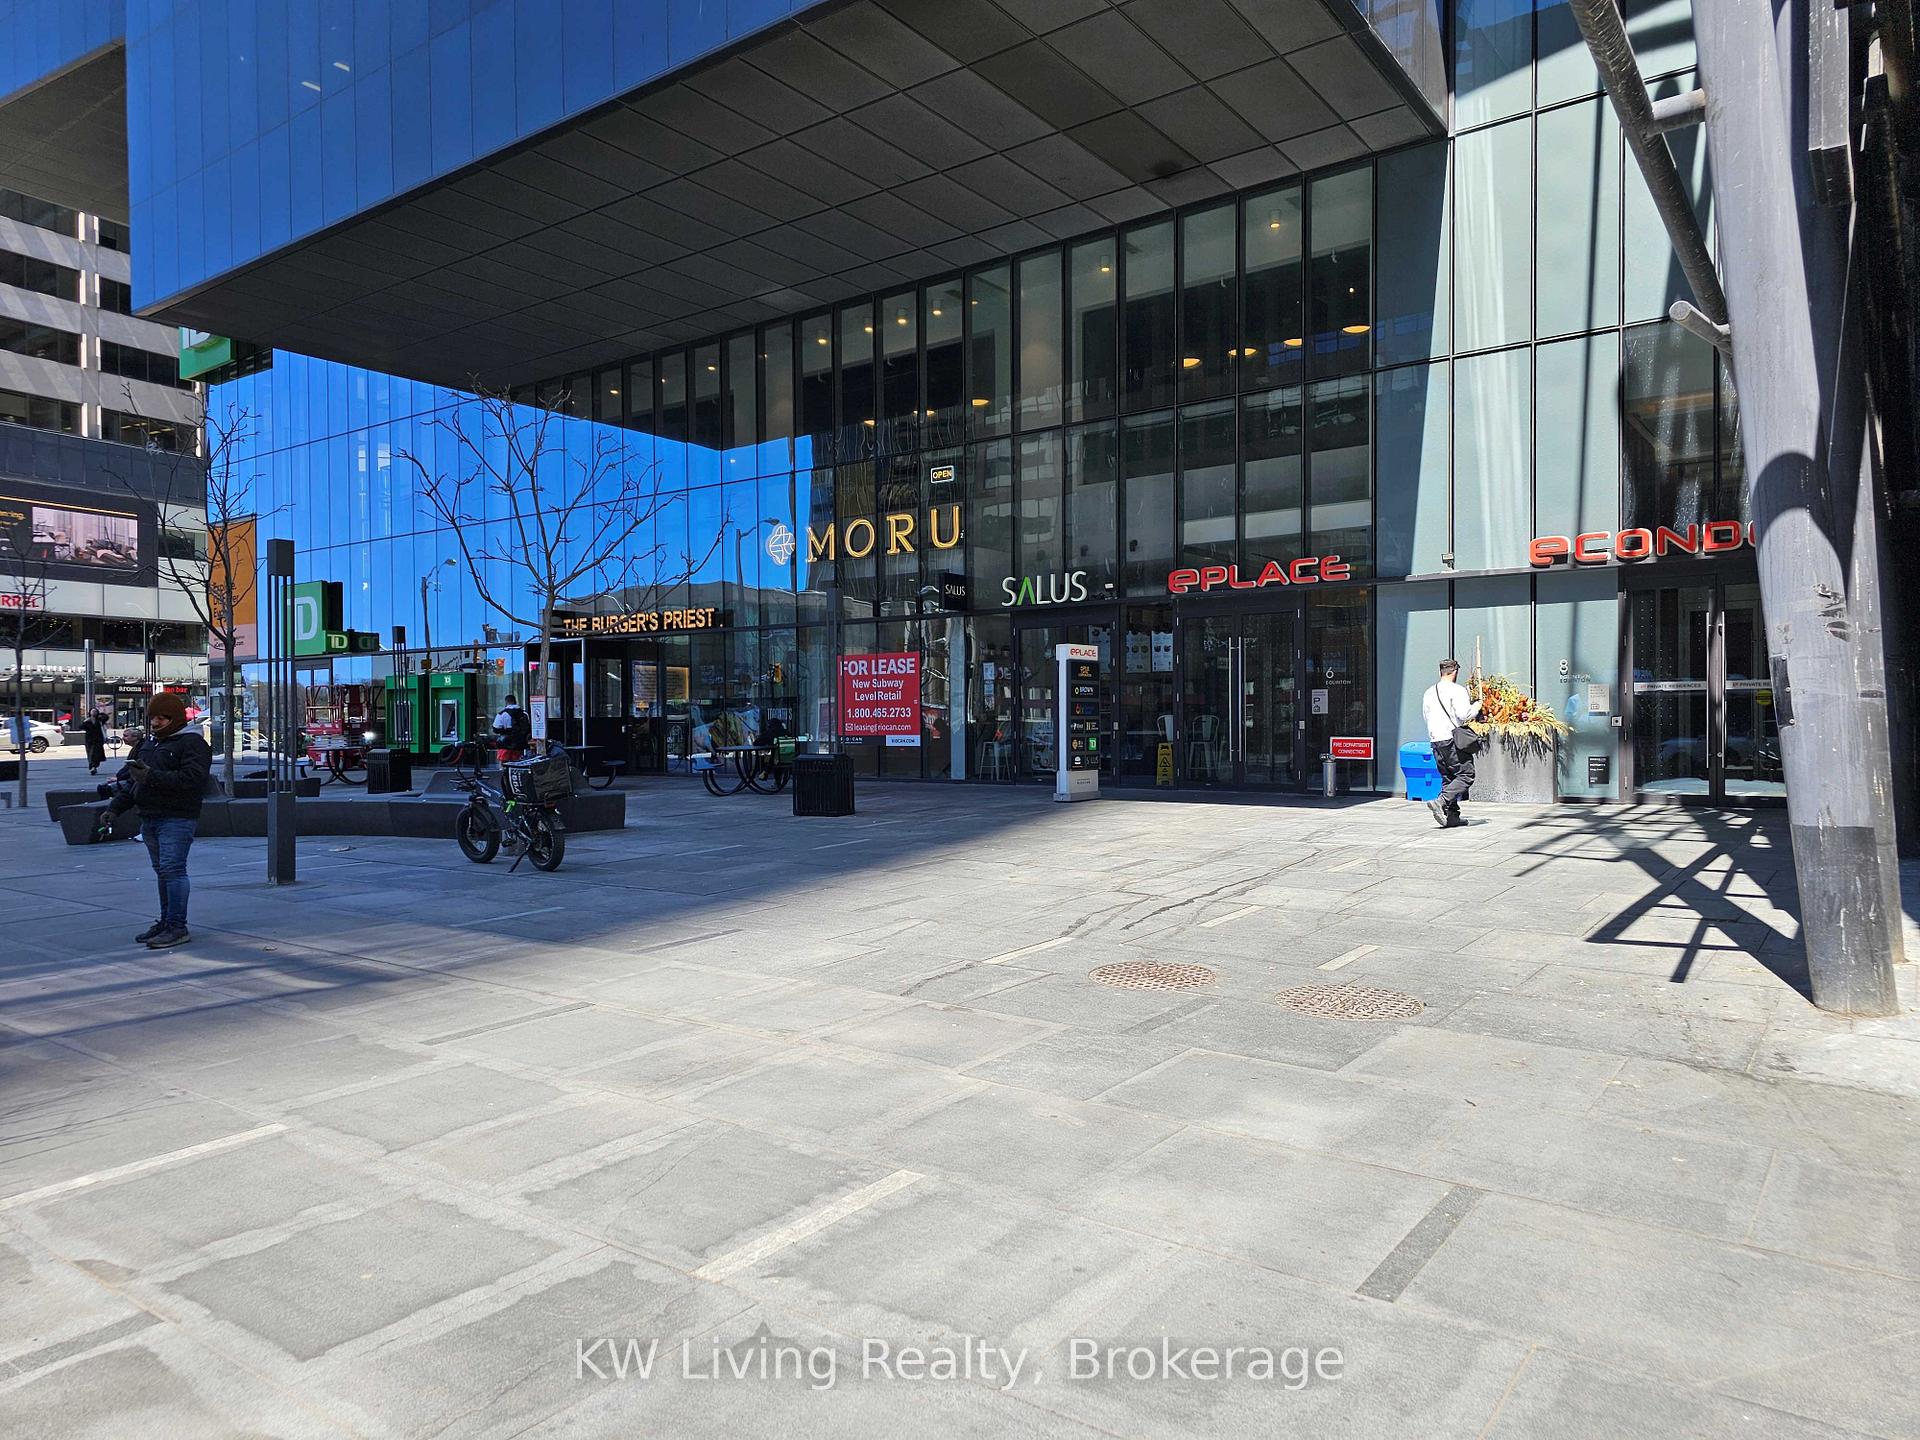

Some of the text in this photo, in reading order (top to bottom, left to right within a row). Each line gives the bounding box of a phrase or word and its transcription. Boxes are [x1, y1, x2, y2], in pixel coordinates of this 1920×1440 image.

[932, 469, 952, 480] OPEN
[806, 505, 960, 563] MORU
[1001, 571, 1088, 606] SALUS
[563, 608, 715, 636] THE BURGER'S PRIEST
[327, 634, 348, 648] TD
[840, 658, 915, 676] FOR LEASE
[1325, 667, 1334, 679] 6
[1560, 659, 1568, 673] 8
[852, 679, 904, 689] New Subway
[855, 691, 901, 701] Level Retail
[848, 708, 912, 718] 1.800.465.2733
